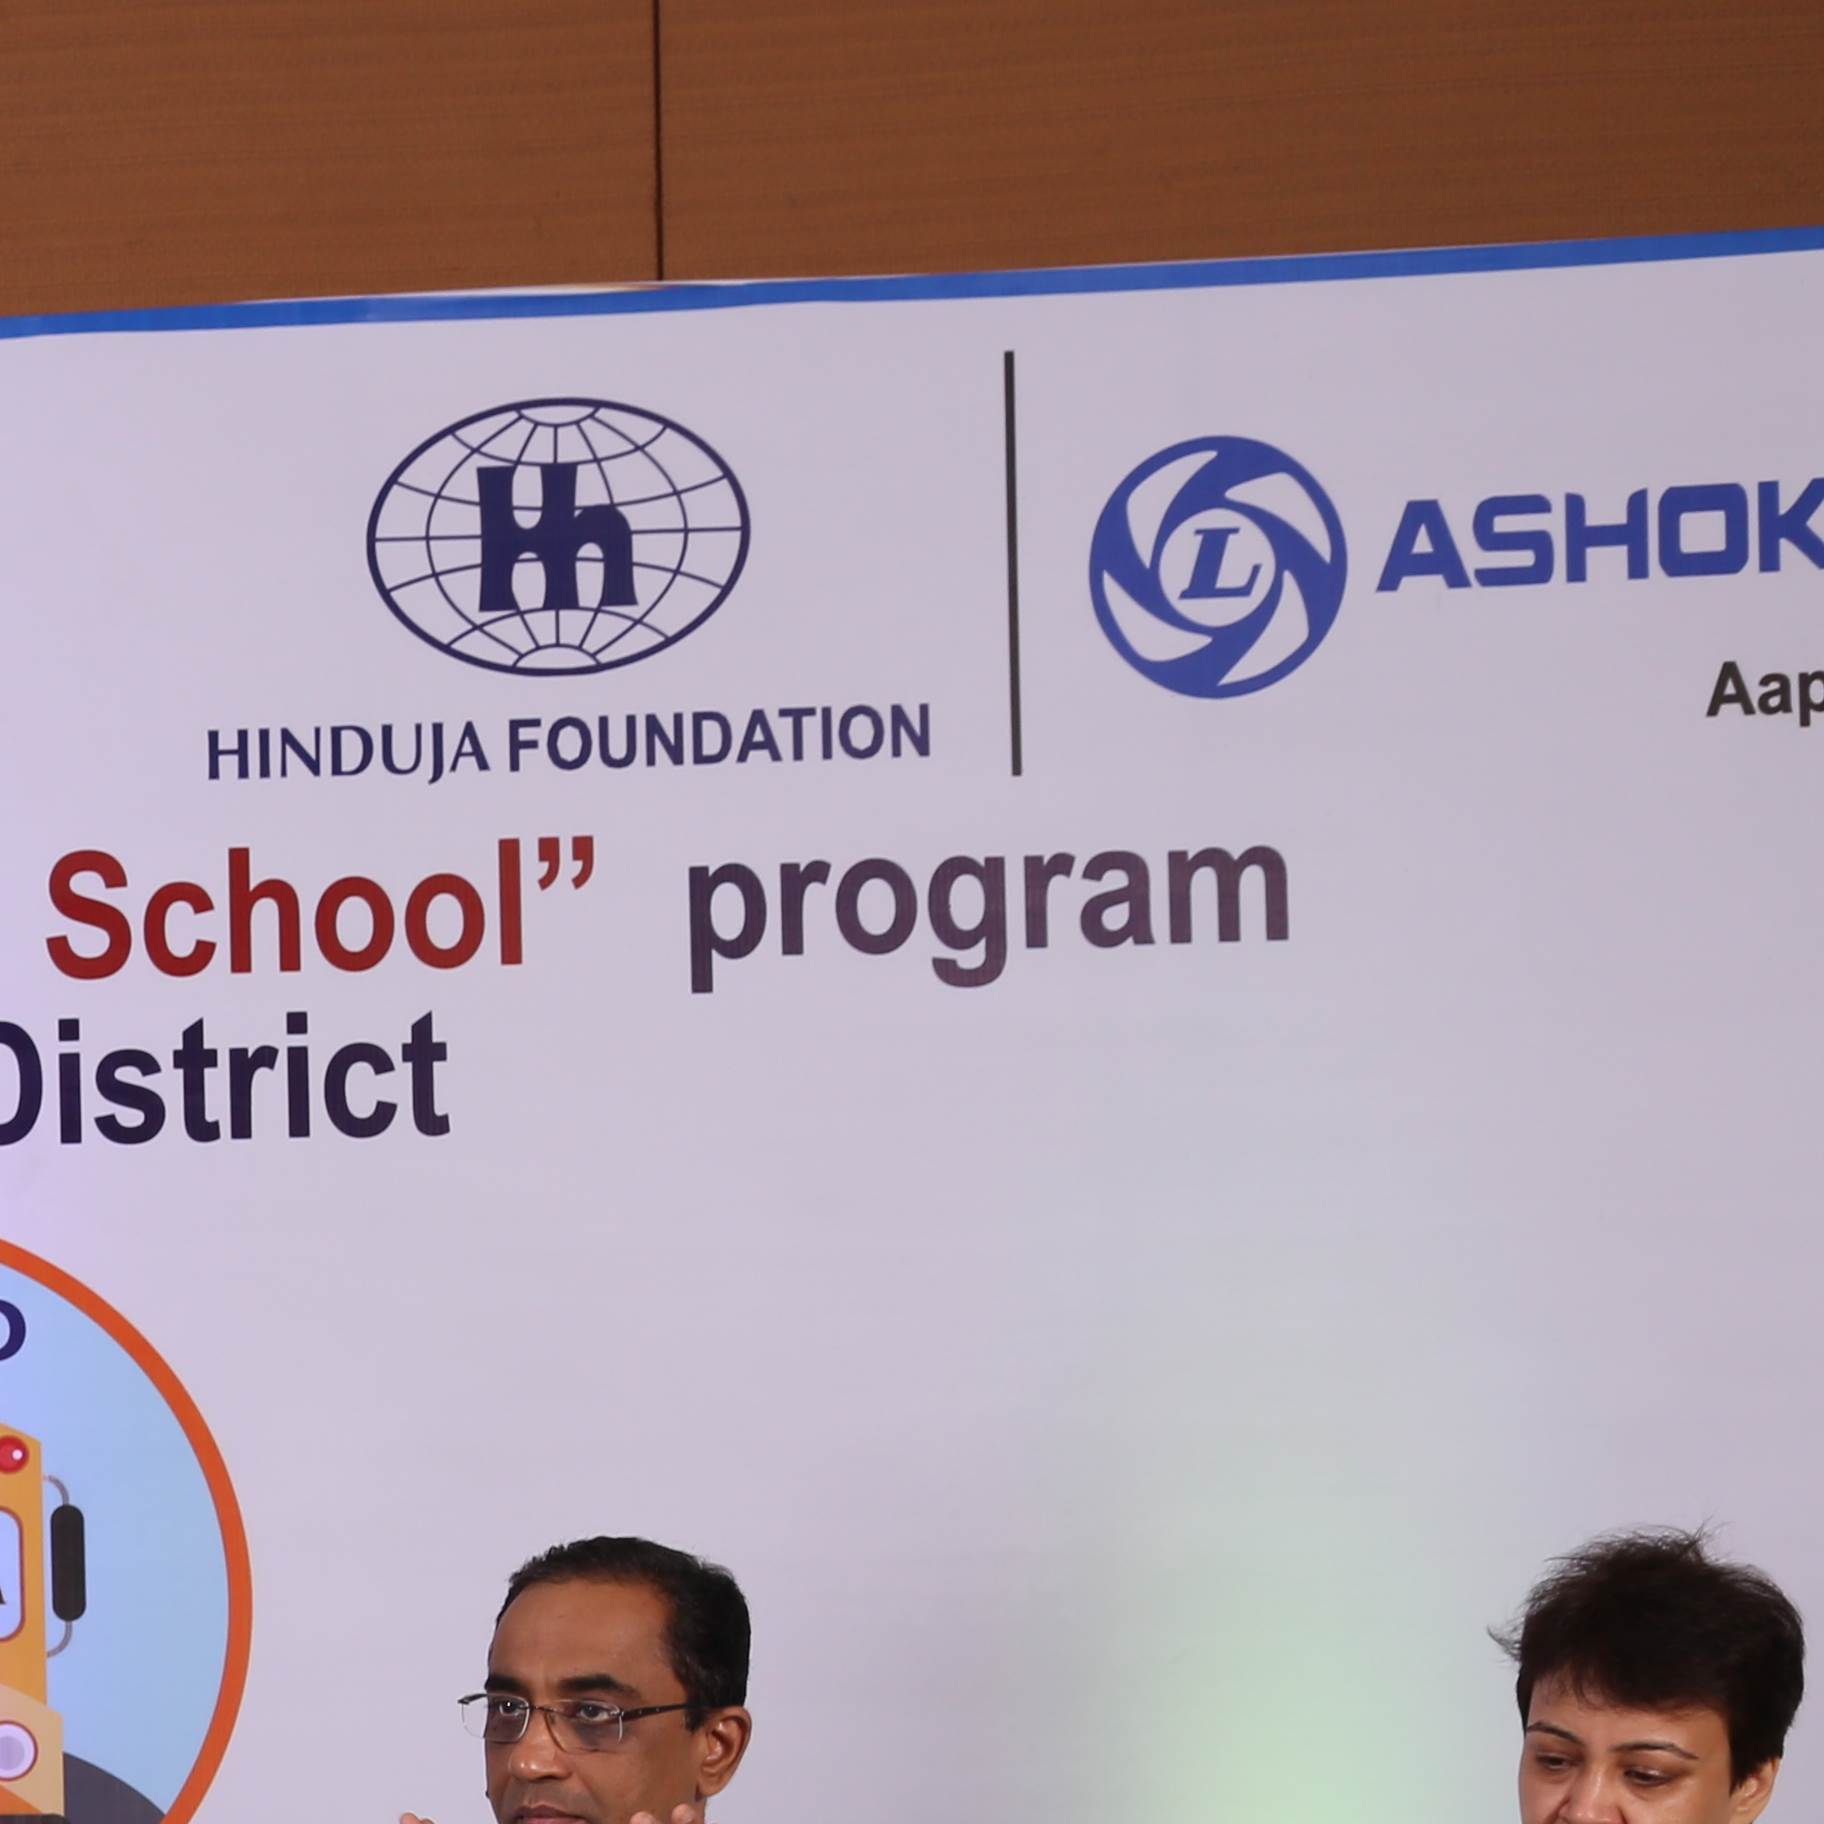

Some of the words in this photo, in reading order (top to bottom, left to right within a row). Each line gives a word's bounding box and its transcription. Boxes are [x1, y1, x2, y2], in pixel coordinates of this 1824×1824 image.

[1376, 478, 1824, 592] ASHOK
[207, 721, 491, 784] HINDUJA
[508, 703, 931, 773] FOUNDATION
[687, 842, 1289, 994] program
